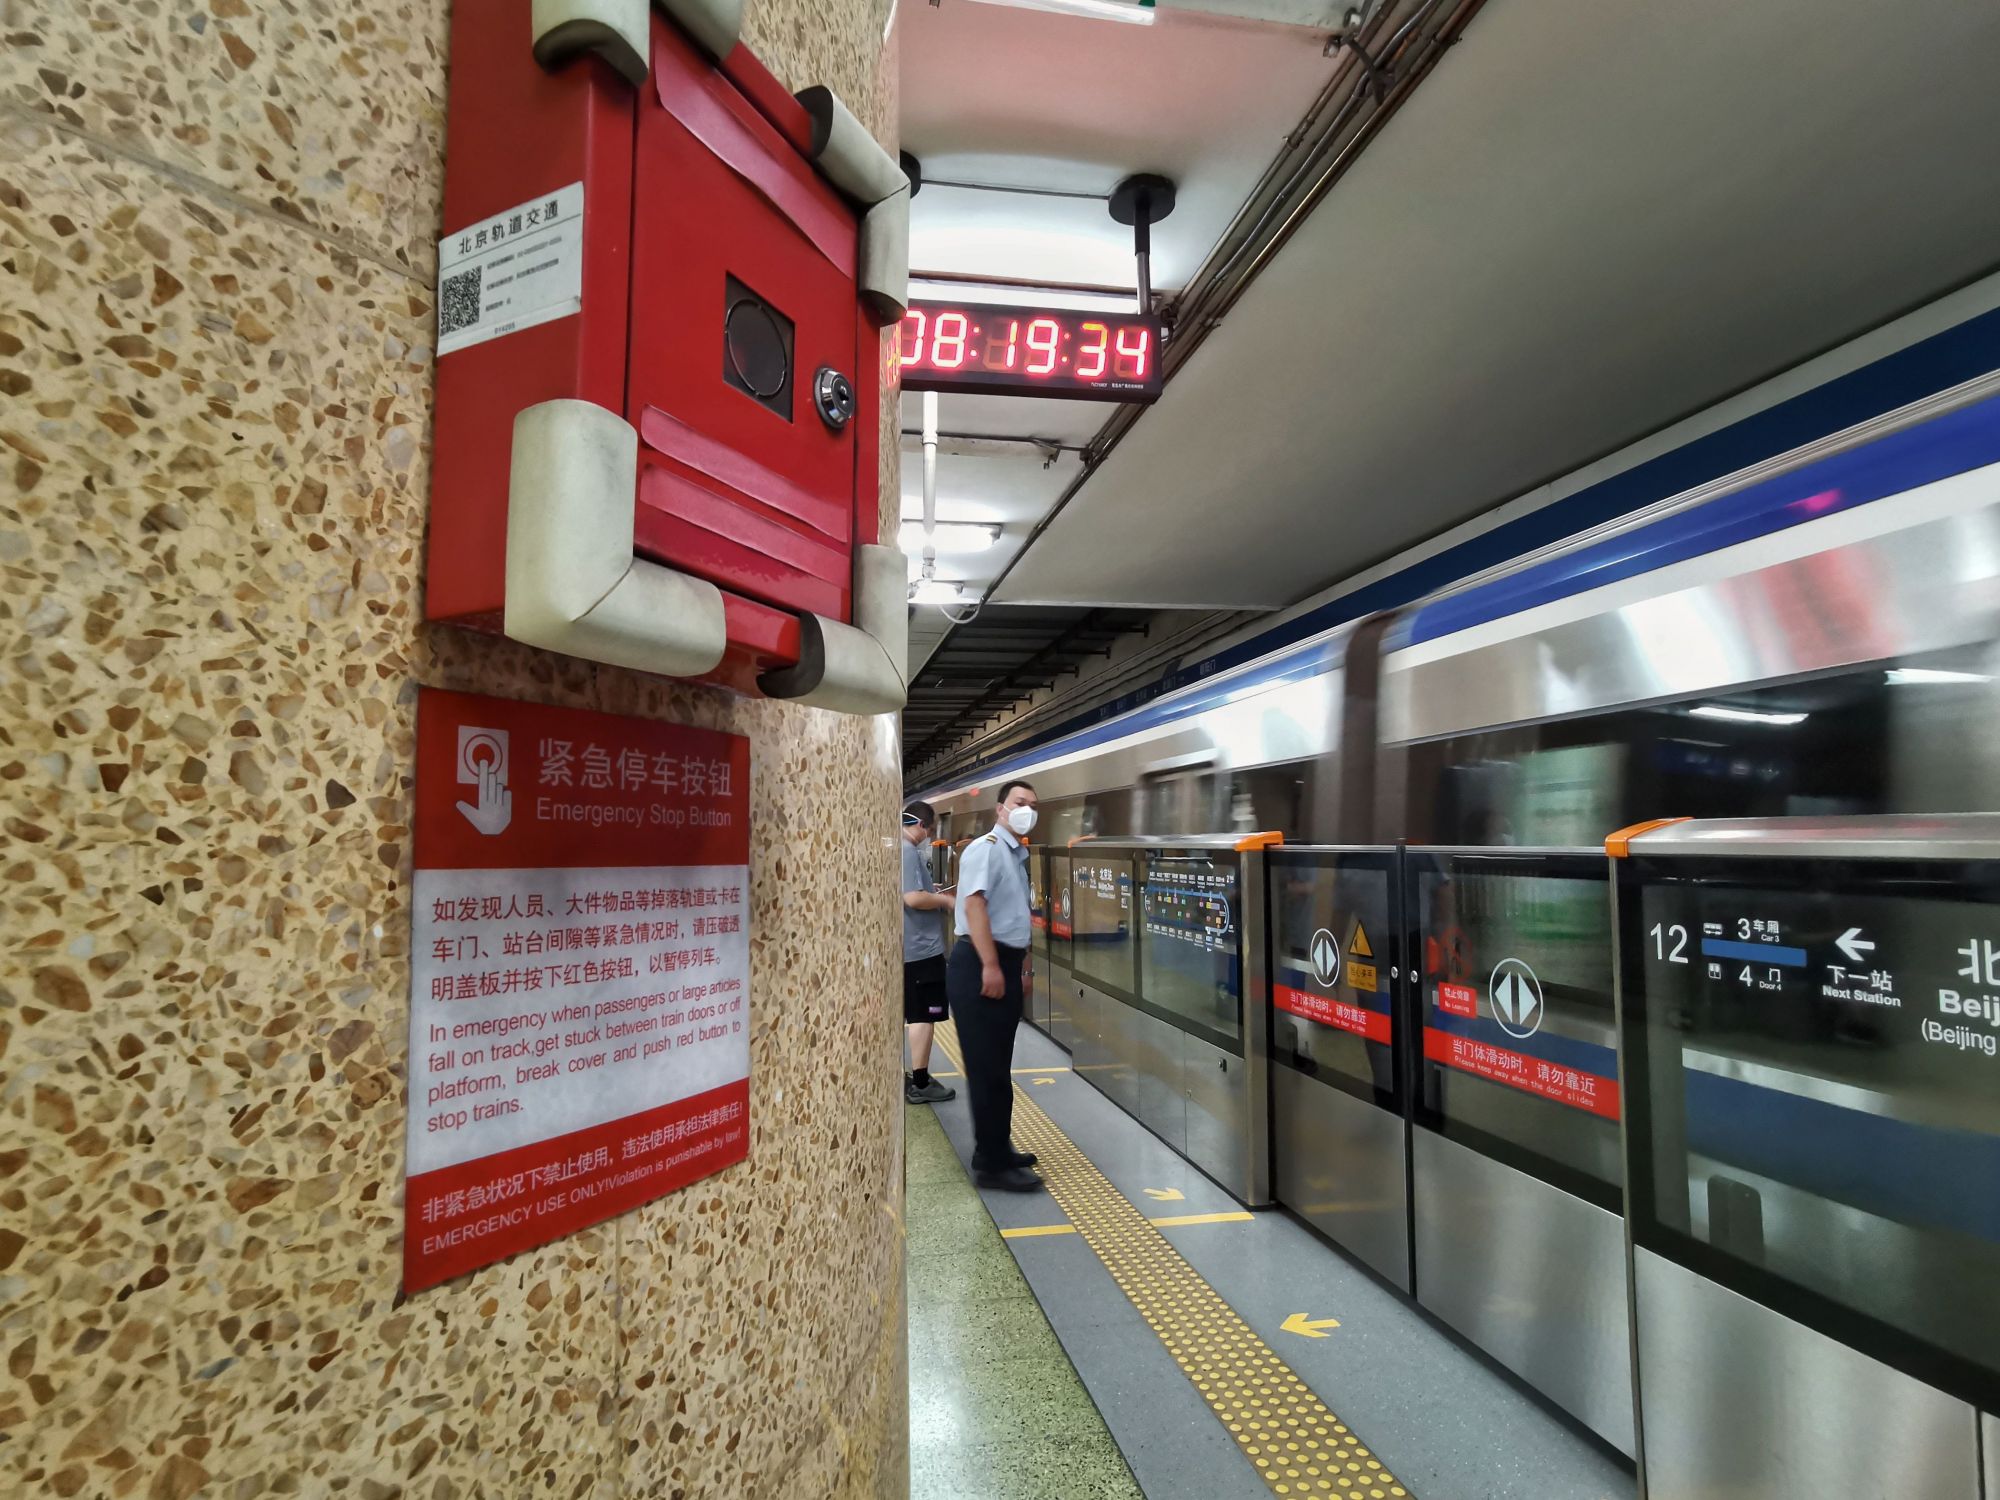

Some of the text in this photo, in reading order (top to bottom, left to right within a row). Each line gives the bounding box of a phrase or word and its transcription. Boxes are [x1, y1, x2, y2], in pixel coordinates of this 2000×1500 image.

[458, 199, 558, 255] 北京轨道交通
[538, 738, 732, 796] 紧急停车按钮
[536, 797, 732, 829] Emergency Stop Button
[1650, 922, 1688, 964] 12
[1761, 933, 1780, 943] Car 3
[1759, 980, 1776, 990] Door
[1822, 985, 1901, 1007] Next Station
[1826, 964, 1893, 992] 下一站
[430, 978, 740, 1043] In emergency when passengers or large articles
[429, 1050, 455, 1073] fall
[462, 1049, 484, 1066] on
[565, 1026, 600, 1047] stuck
[606, 1018, 657, 1040] between
[661, 1009, 684, 1028] train
[688, 1004, 714, 1022] doors
[717, 1003, 727, 1015] or
[729, 996, 741, 1012] off
[1921, 1017, 1997, 1056] (Beijing
[428, 1020, 741, 1107] platform, break cover and push red button to
[1453, 1039, 1596, 1096] 当门体滑动时，请勿靠近
[1454, 1055, 1475, 1068] Please
[1530, 1081, 1543, 1090] the
[1546, 1085, 1562, 1096] door
[427, 1098, 524, 1133] stop trains.
[423, 1204, 532, 1255] EMERGENCY
[536, 1193, 566, 1215] USE
[655, 1160, 664, 1172] is
[666, 1140, 713, 1171] punishable
[714, 1136, 724, 1149] by
